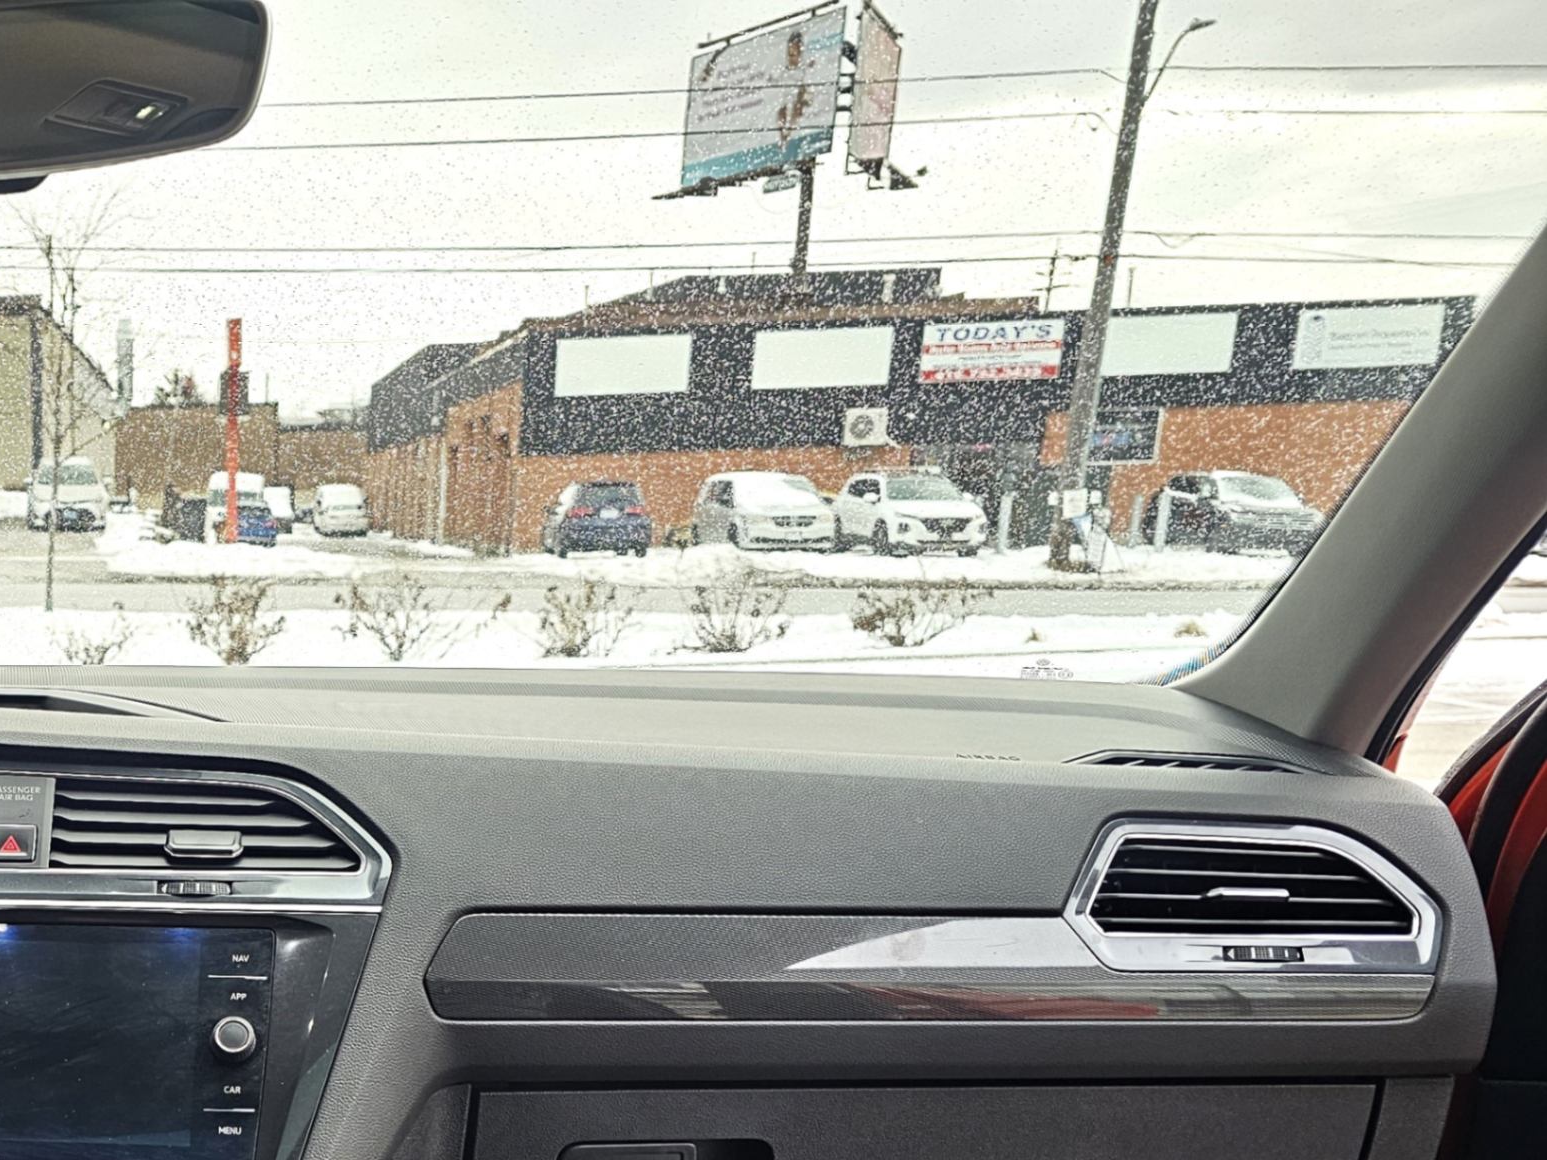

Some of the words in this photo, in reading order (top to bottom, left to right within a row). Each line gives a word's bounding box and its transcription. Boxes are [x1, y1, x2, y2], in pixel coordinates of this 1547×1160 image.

[937, 324, 1052, 341] TODAY'S
[956, 753, 1021, 761] AIRBAG
[15, 793, 34, 801] BAG
[232, 954, 250, 963] NAV
[230, 992, 247, 1001] APP
[223, 1085, 241, 1094] CAR
[218, 1126, 242, 1135] MENU
